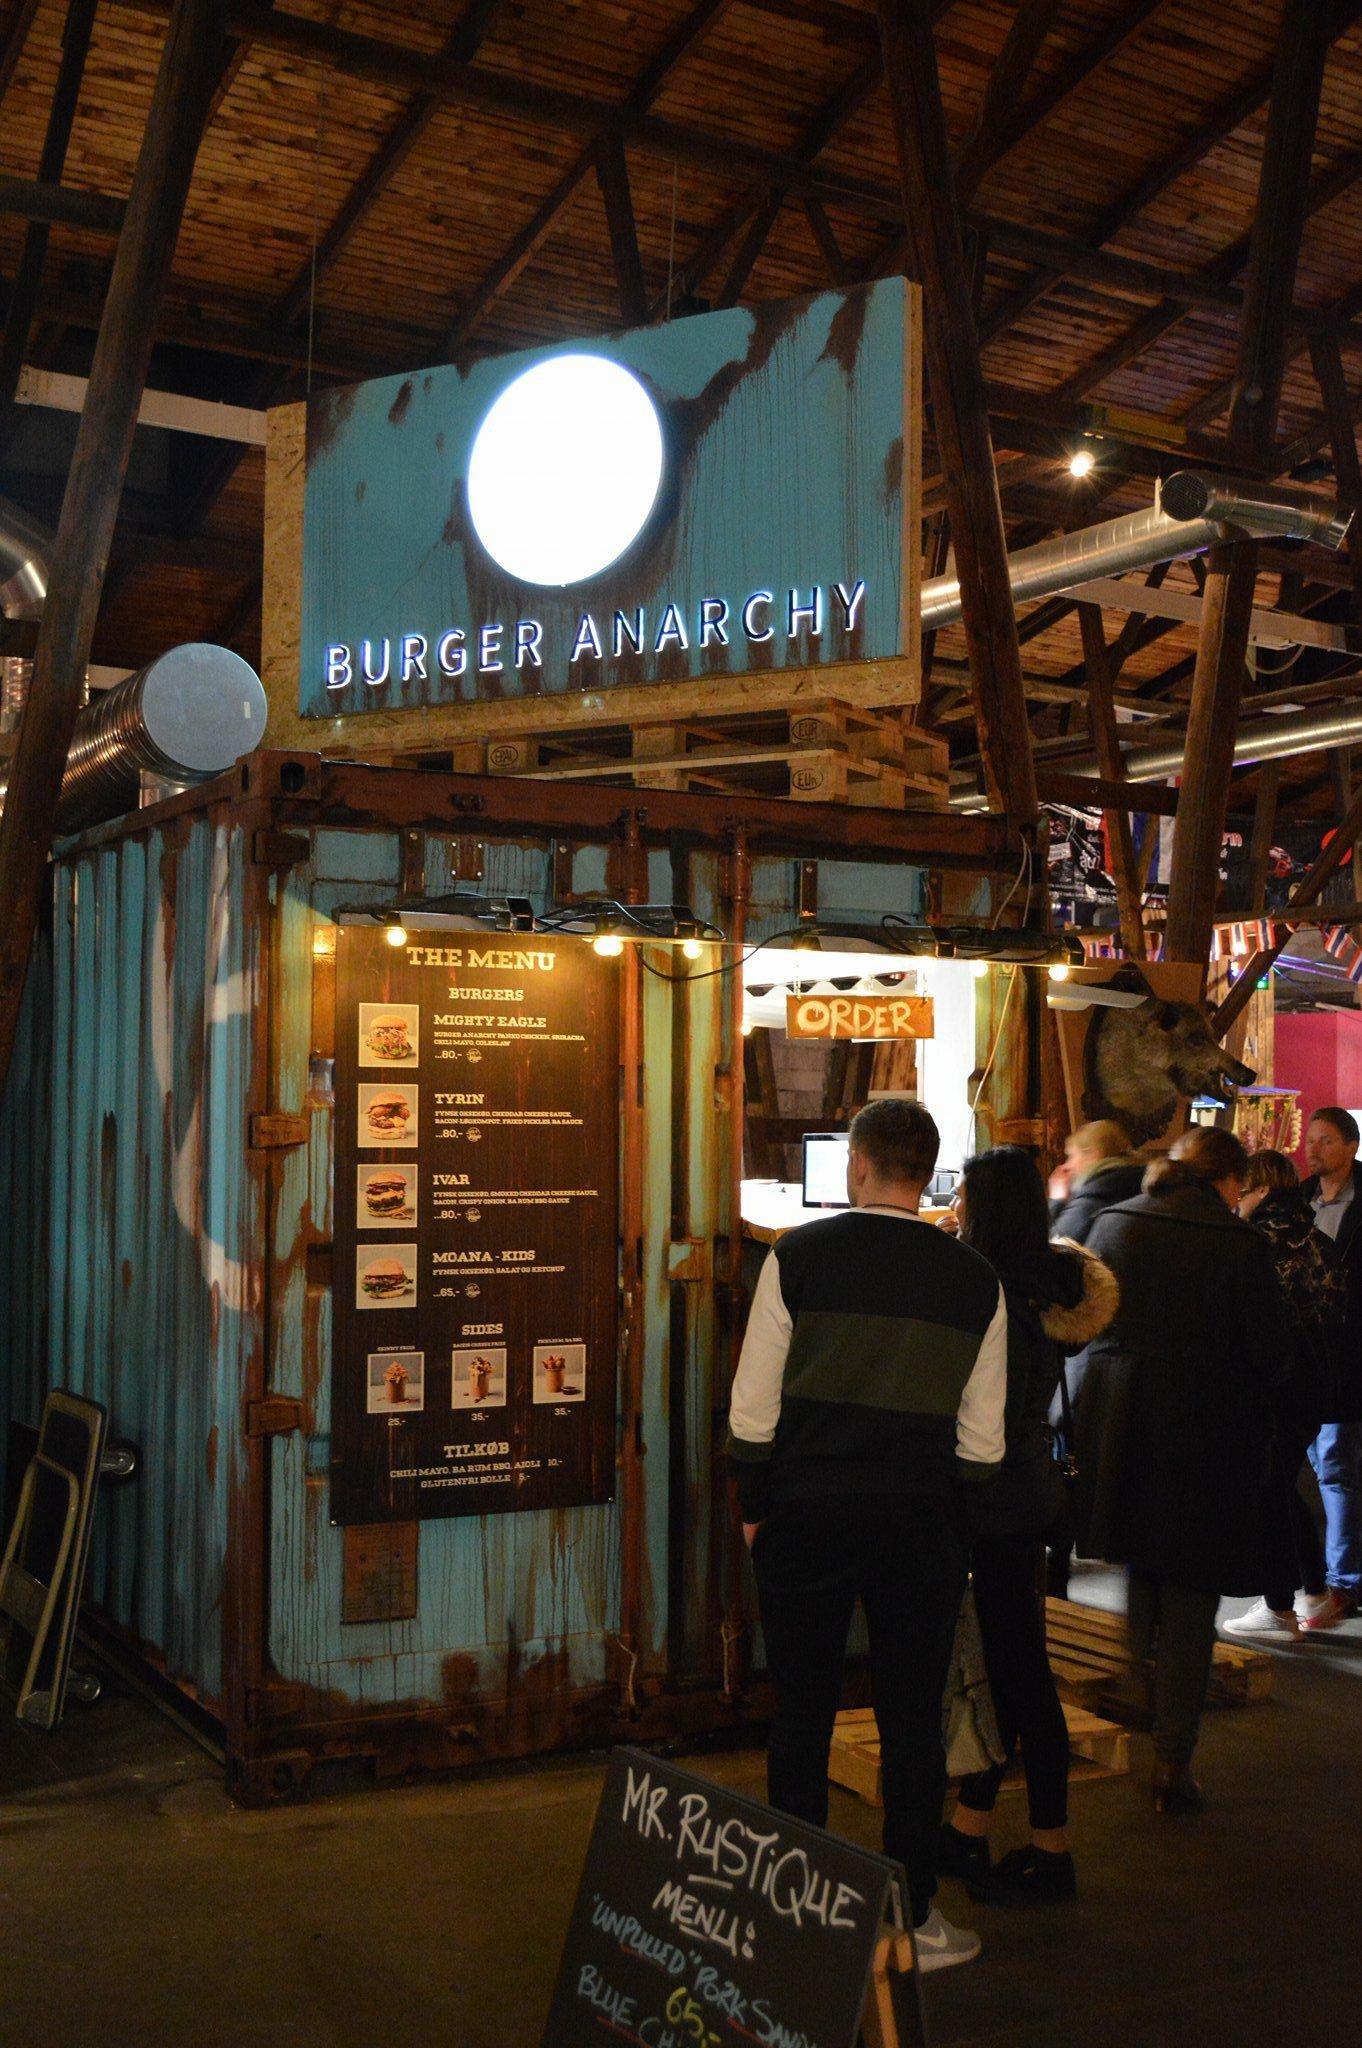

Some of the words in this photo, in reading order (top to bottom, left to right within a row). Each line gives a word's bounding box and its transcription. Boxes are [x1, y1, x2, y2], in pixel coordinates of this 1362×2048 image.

[324, 620, 543, 690] BURGER
[570, 580, 866, 662] ANARCHY
[406, 946, 462, 966] THE
[468, 949, 556, 970] MENU
[449, 988, 524, 1001] BURGERS
[434, 1014, 496, 1026] MIGHTY
[498, 1016, 547, 1028] EAGLE
[797, 998, 916, 1038] ORDER
[434, 1094, 484, 1104] TYRIN
[433, 1174, 470, 1185] IVAR
[432, 1252, 493, 1263] MOANA
[501, 1250, 536, 1261] KIDS
[462, 1323, 503, 1336] SIDES
[444, 1441, 510, 1458] TILKØB
[390, 1470, 418, 1478] CHILI
[452, 1465, 466, 1474] BA
[468, 1464, 492, 1472] RUM
[514, 1460, 540, 1469] AIOLI
[421, 1476, 479, 1488] GLUTENFRI
[480, 1474, 511, 1483] BOLLE
[622, 1766, 673, 1840] MR.
[577, 1964, 638, 2026] BLUE
[694, 1965, 749, 2025] PORK
